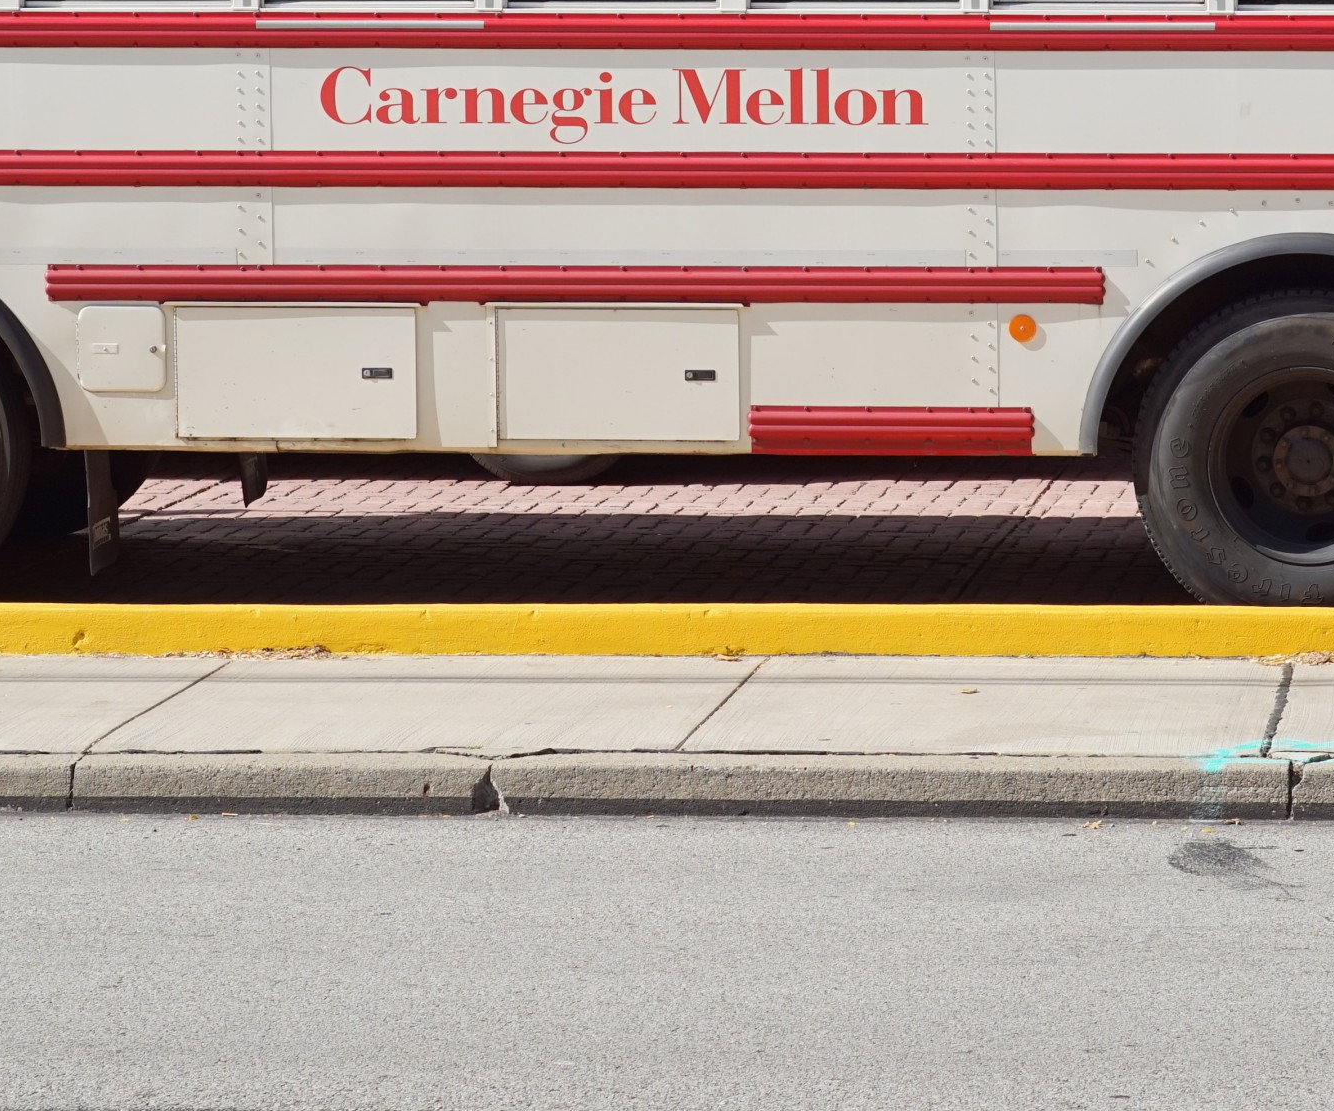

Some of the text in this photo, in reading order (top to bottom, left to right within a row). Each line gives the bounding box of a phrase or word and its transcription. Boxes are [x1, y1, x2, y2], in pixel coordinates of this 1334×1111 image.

[319, 66, 929, 145] Carnegie Mellon
[1168, 436, 1325, 605] Firestone
